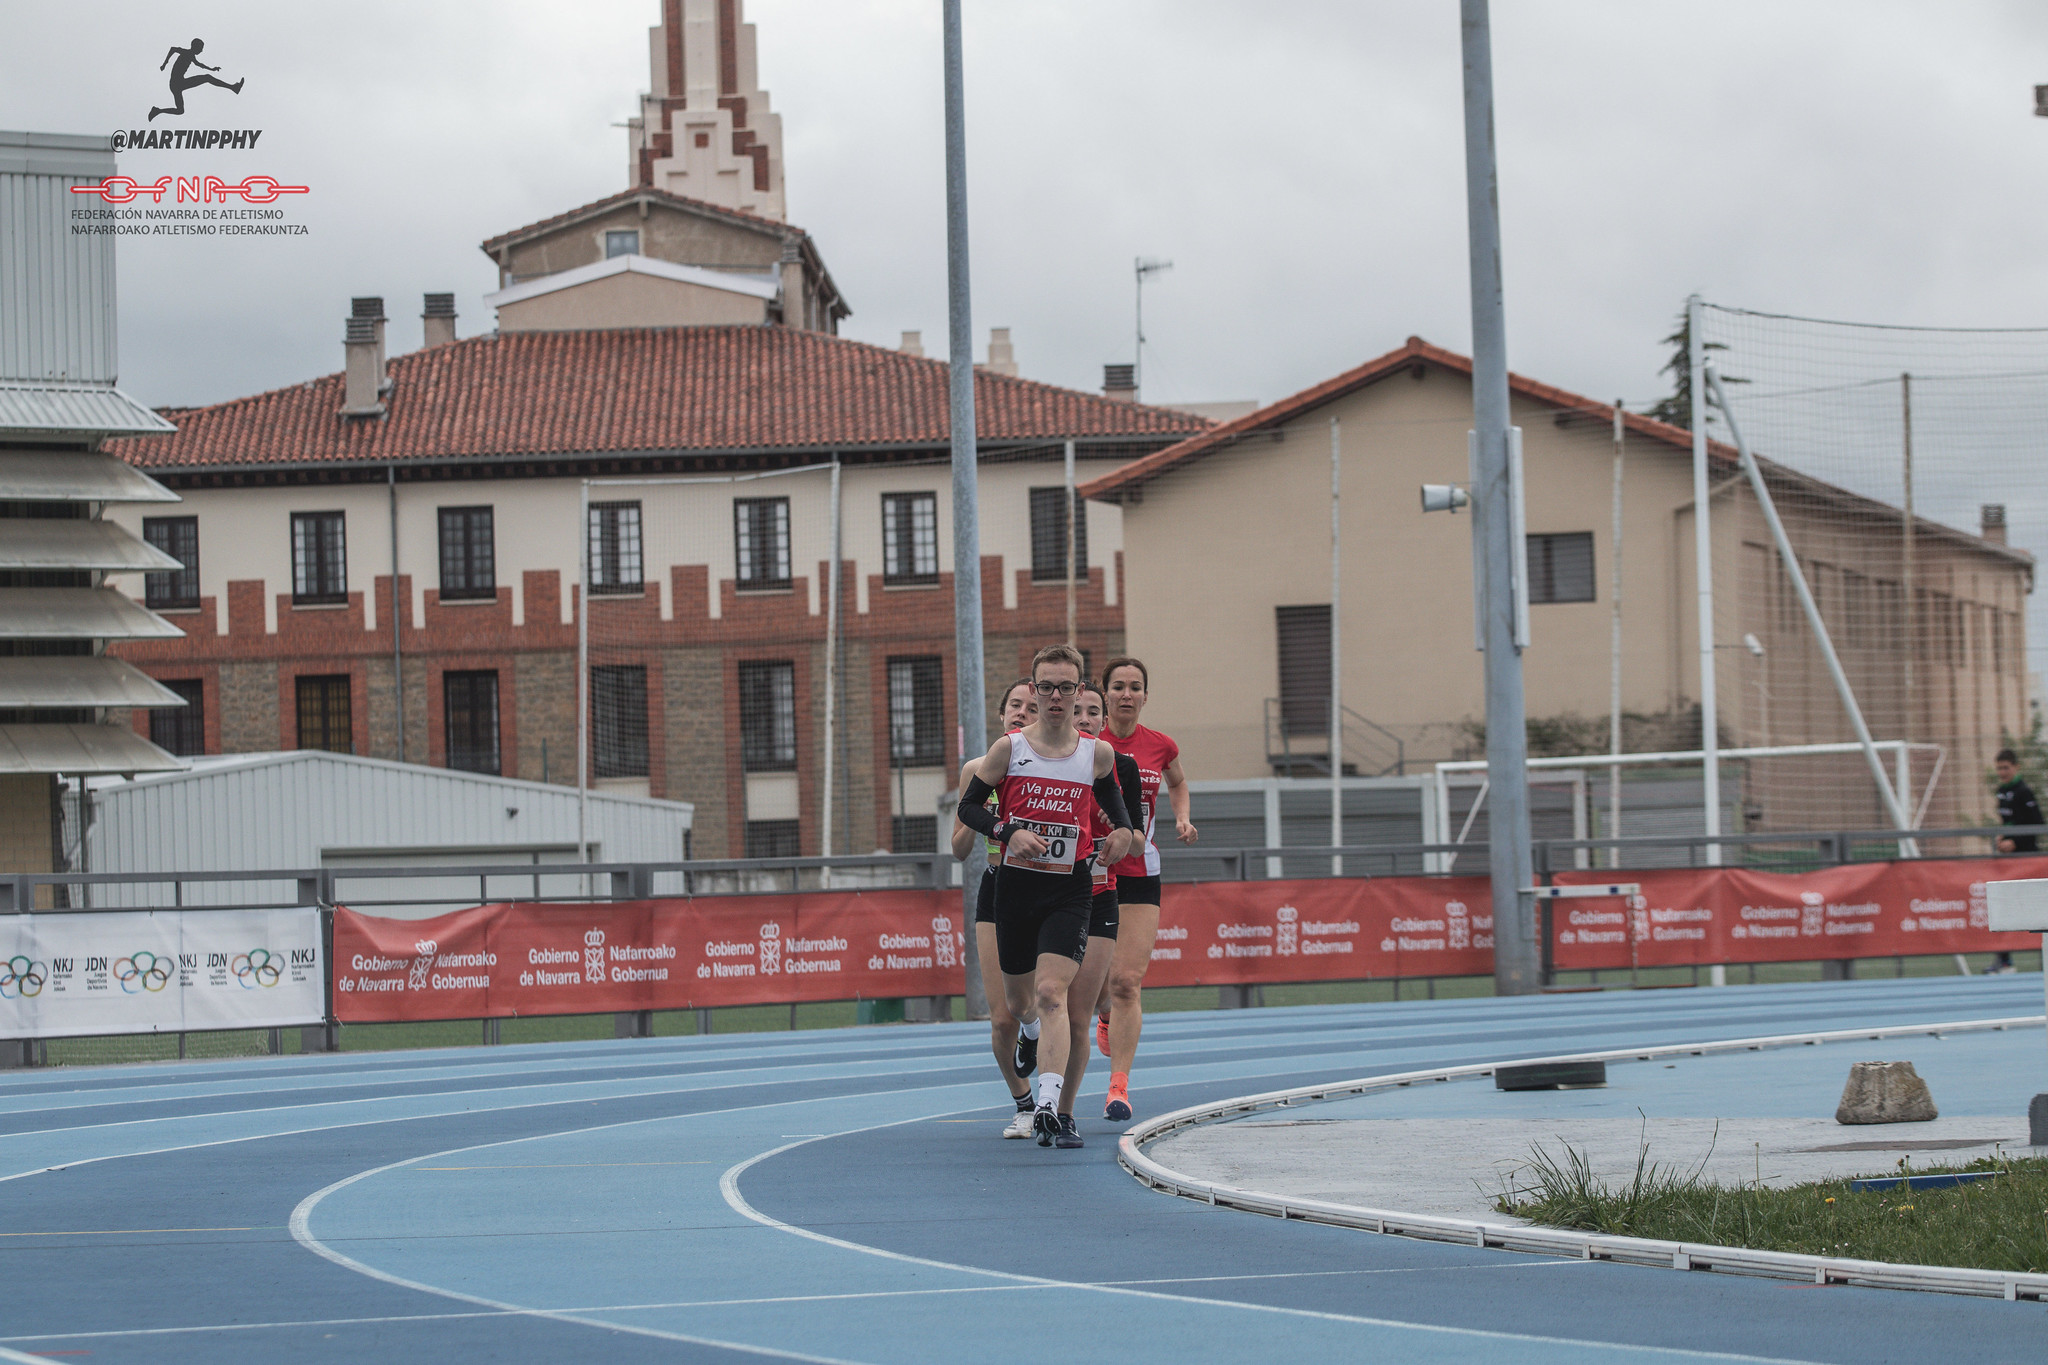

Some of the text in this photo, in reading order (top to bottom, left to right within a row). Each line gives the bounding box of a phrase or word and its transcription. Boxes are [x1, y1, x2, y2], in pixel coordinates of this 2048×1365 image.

[1044, 785, 1068, 797] por
[1070, 787, 1083, 799] ti!
[1027, 798, 1073, 813] HAMZA
[1217, 923, 1273, 938] Gobierno
[1302, 920, 1360, 935] Nafarroako
[1391, 917, 1445, 932] Gobierno
[705, 940, 755, 957] Gobierno
[786, 936, 848, 953] Nafarroako
[879, 933, 930, 949] Gobierno
[1301, 940, 1353, 955] Gobernua
[1380, 937, 1445, 952] de Navarra
[291, 948, 315, 963] NKJ
[528, 948, 579, 965] Gobierno
[610, 944, 676, 961] Nafarroako
[1207, 943, 1272, 958] de Navarra
[53, 958, 73, 972] NKJ
[85, 957, 107, 971] JDN
[179, 954, 197, 968] NKJ
[207, 953, 227, 967] JDN
[352, 954, 408, 971] Gobierno
[435, 951, 497, 968] Nafarroako
[785, 958, 841, 974] Gobernua
[868, 954, 932, 970] de Navarra
[520, 969, 580, 986] de Navarra
[611, 966, 668, 982] Gobernua
[697, 962, 755, 978] de Navarra
[339, 976, 404, 992] de Navarra
[432, 973, 490, 990] Gobernua
